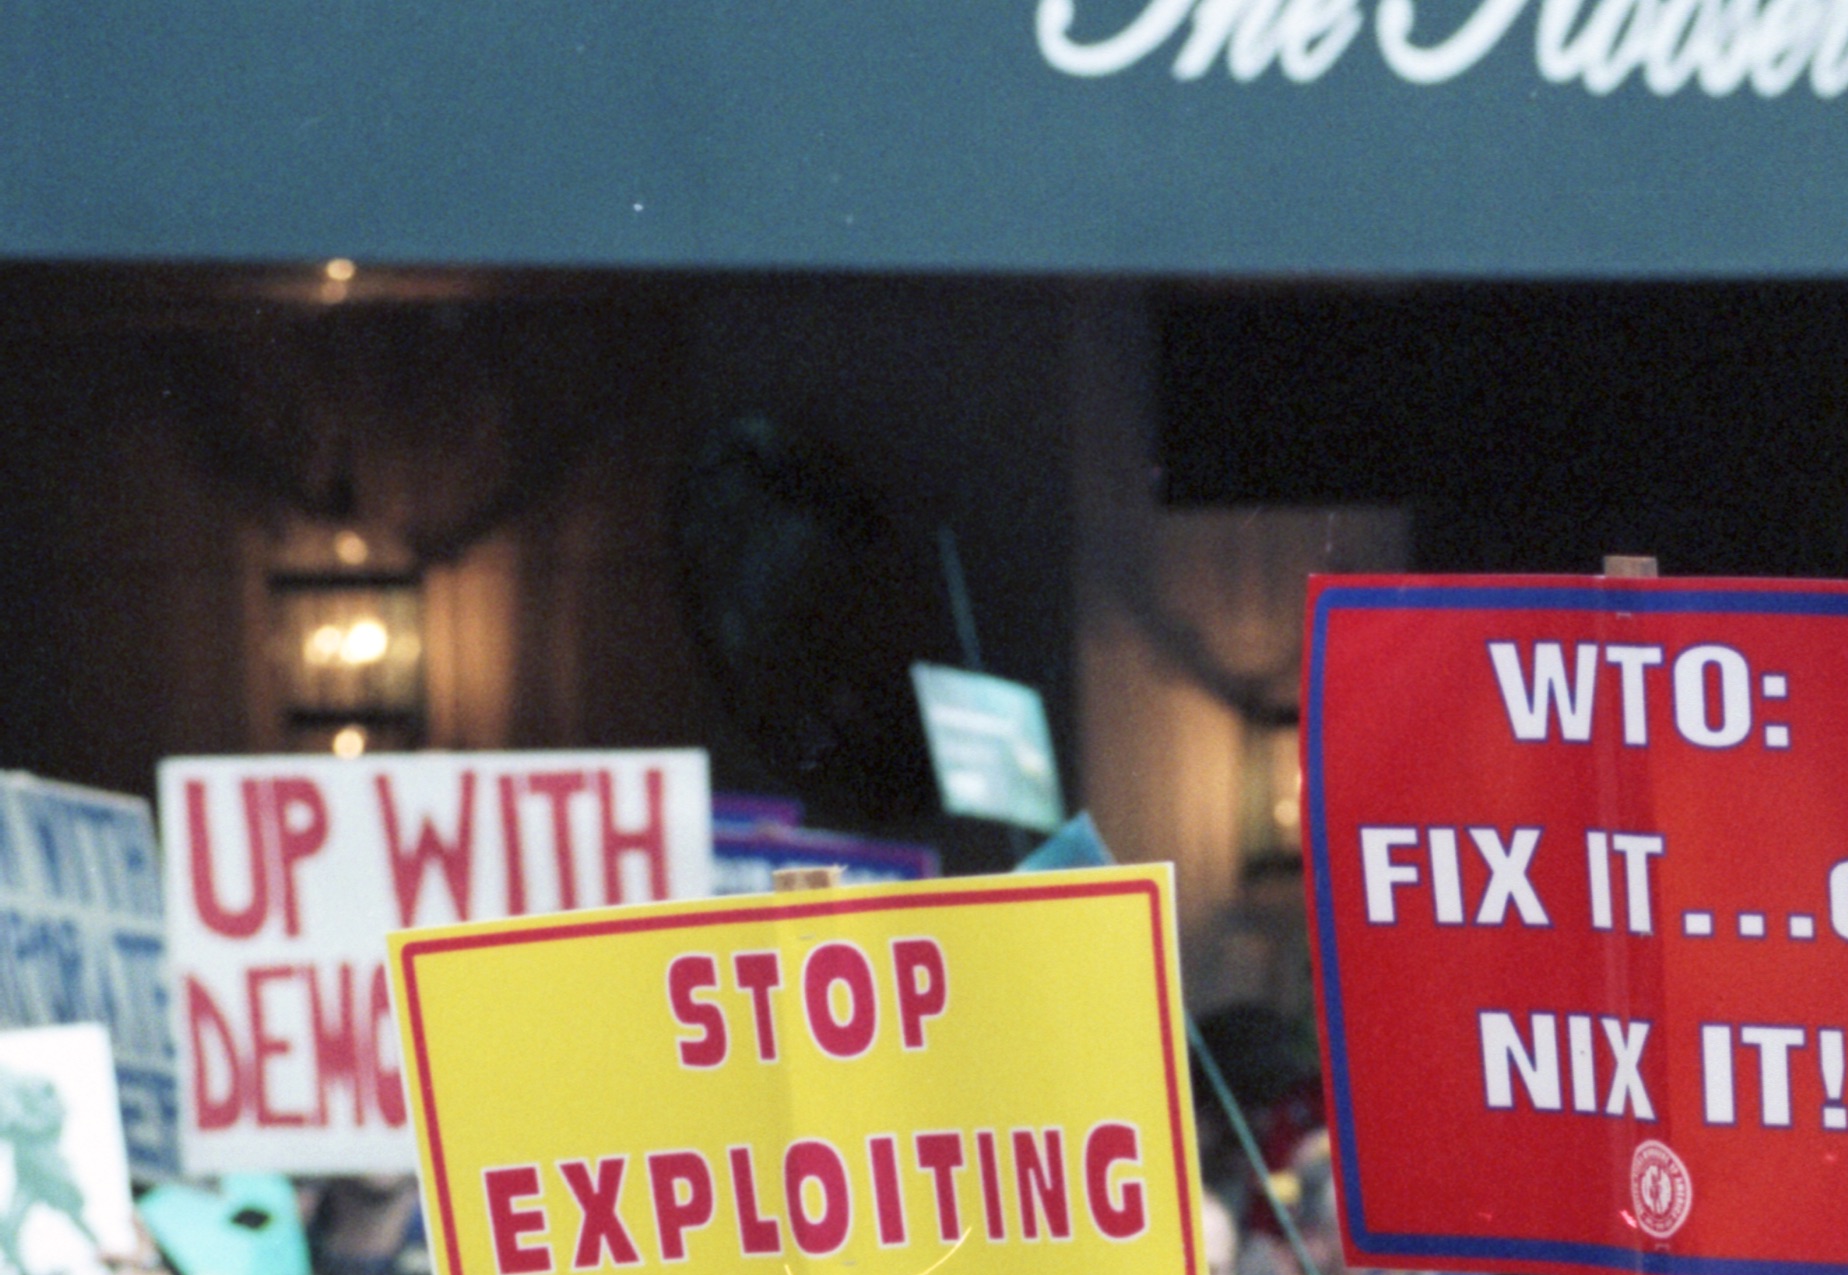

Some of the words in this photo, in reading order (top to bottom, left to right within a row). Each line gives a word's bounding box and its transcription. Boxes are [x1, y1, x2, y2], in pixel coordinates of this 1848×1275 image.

[1488, 641, 1791, 749] WTO:
[183, 776, 329, 940] UP
[373, 768, 671, 928] WITH
[1360, 826, 1550, 926] FIX
[668, 939, 948, 1068] STOP
[1478, 1011, 1655, 1122] NIX
[1700, 1023, 1848, 1131] IT!
